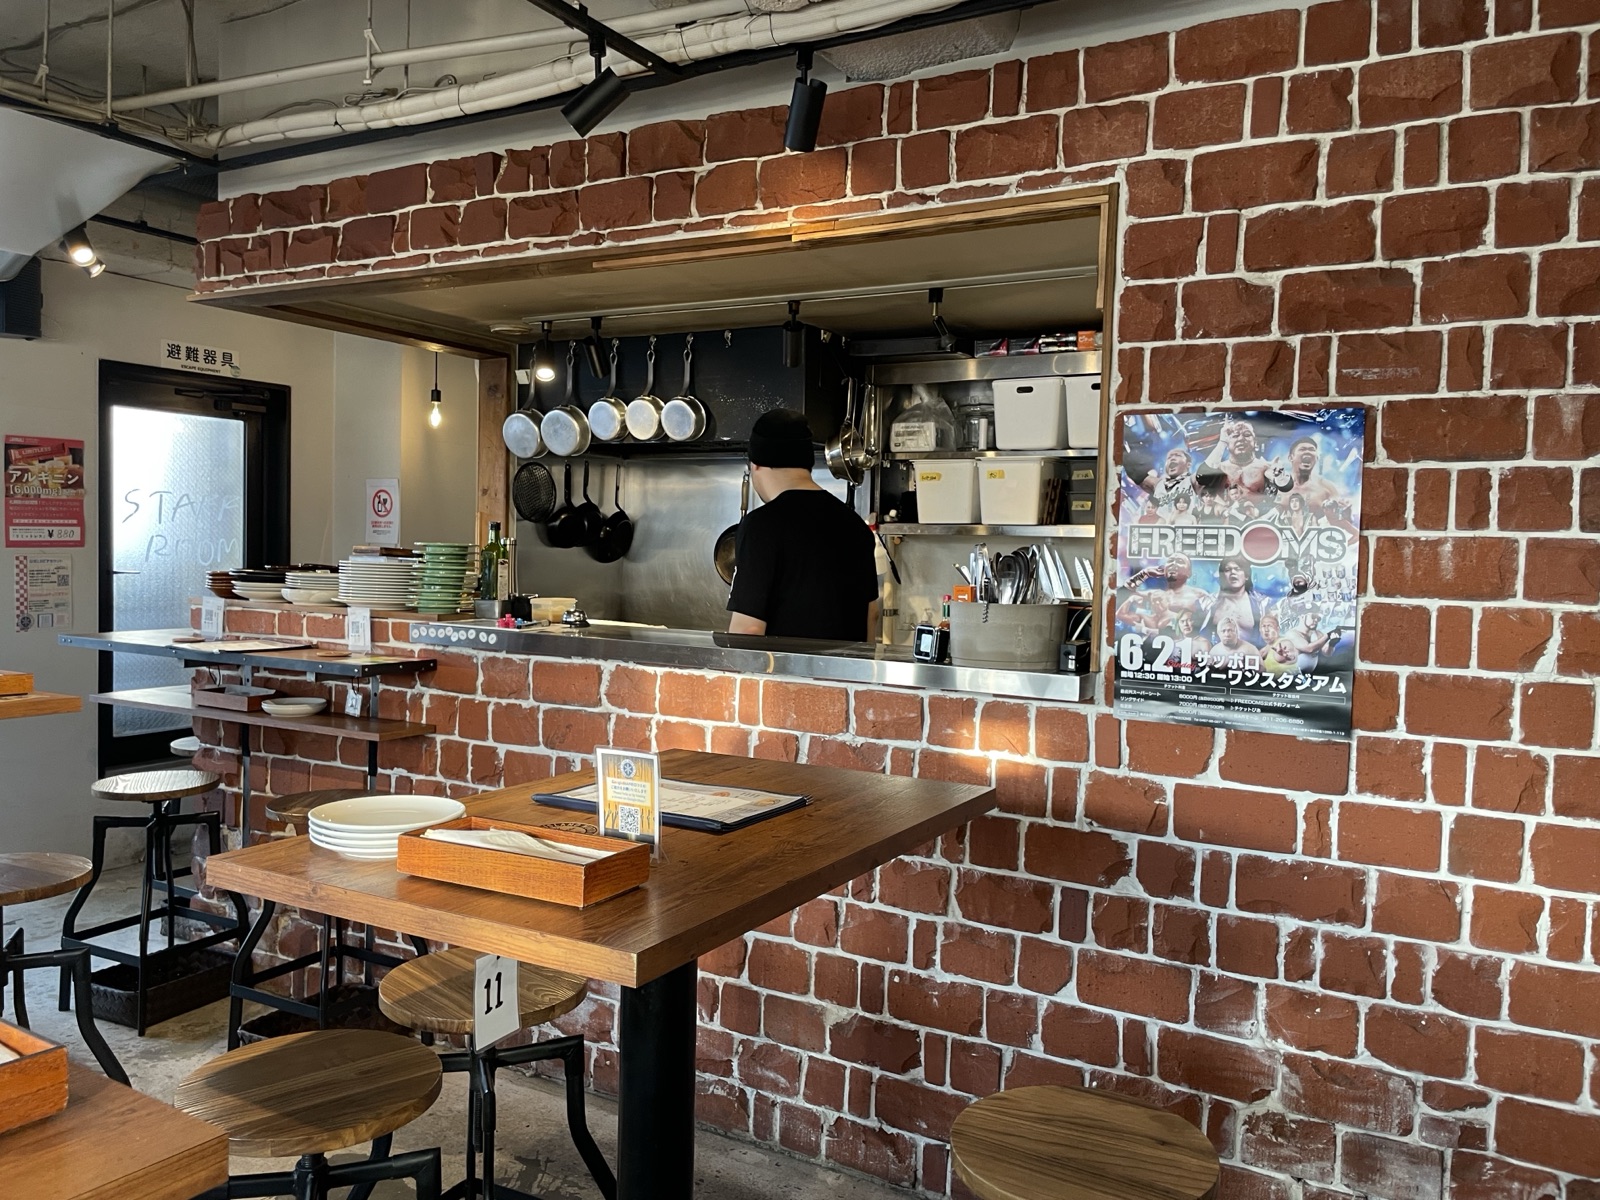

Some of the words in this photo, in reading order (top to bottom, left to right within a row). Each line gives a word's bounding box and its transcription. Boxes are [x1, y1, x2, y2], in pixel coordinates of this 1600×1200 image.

[166, 343, 236, 367] 避難器具
[197, 366, 221, 374] EQUIPMENT
[9, 470, 79, 485] アルキニン
[1128, 521, 1348, 566] FREEDOMS
[1120, 633, 1193, 674] 6.21
[1195, 651, 1260, 671] サッポロ
[1195, 666, 1347, 694] イーワンスタジアム
[484, 971, 503, 1015] 11
